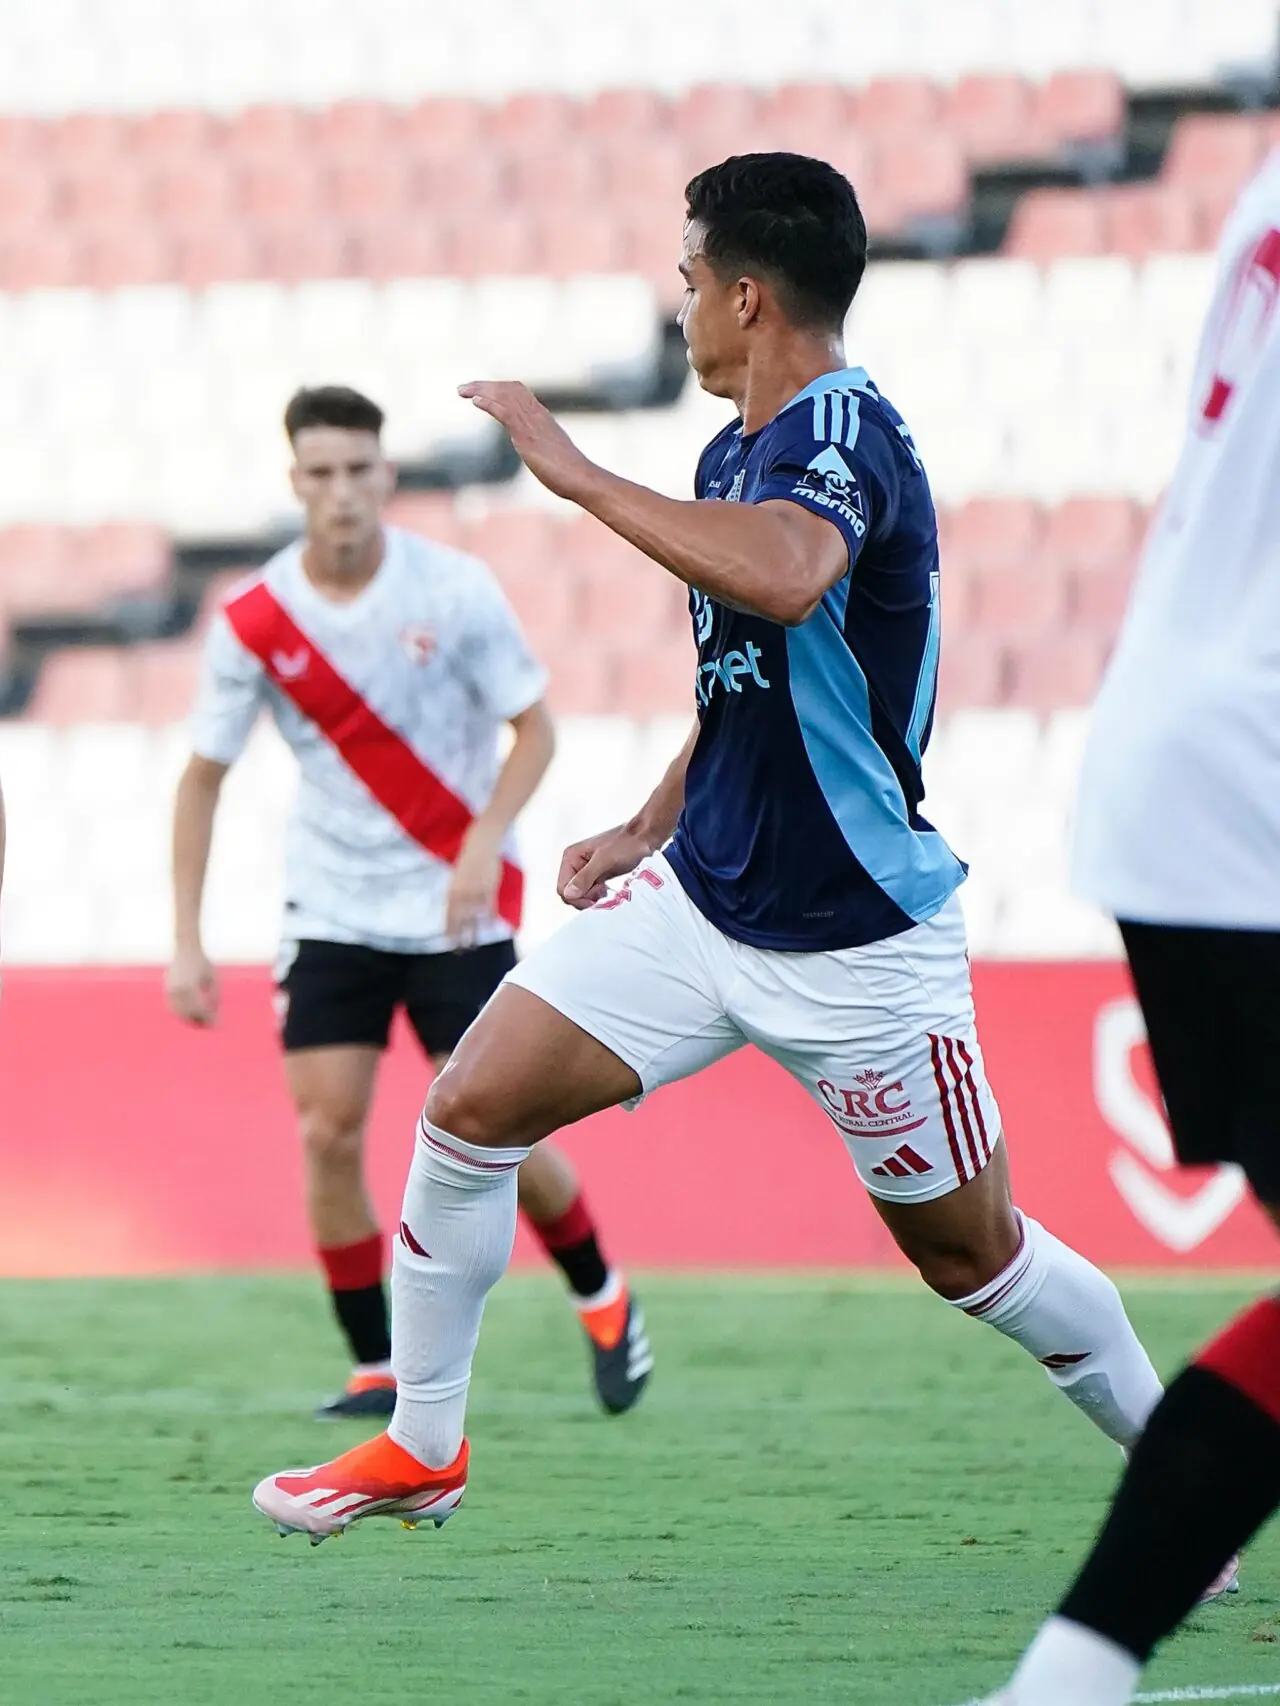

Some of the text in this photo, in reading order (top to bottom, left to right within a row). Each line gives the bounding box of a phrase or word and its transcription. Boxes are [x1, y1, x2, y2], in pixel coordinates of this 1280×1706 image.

[791, 487, 866, 538] marmo
[817, 1079, 912, 1119] CRC
[868, 1111, 915, 1128] CENTRAL
